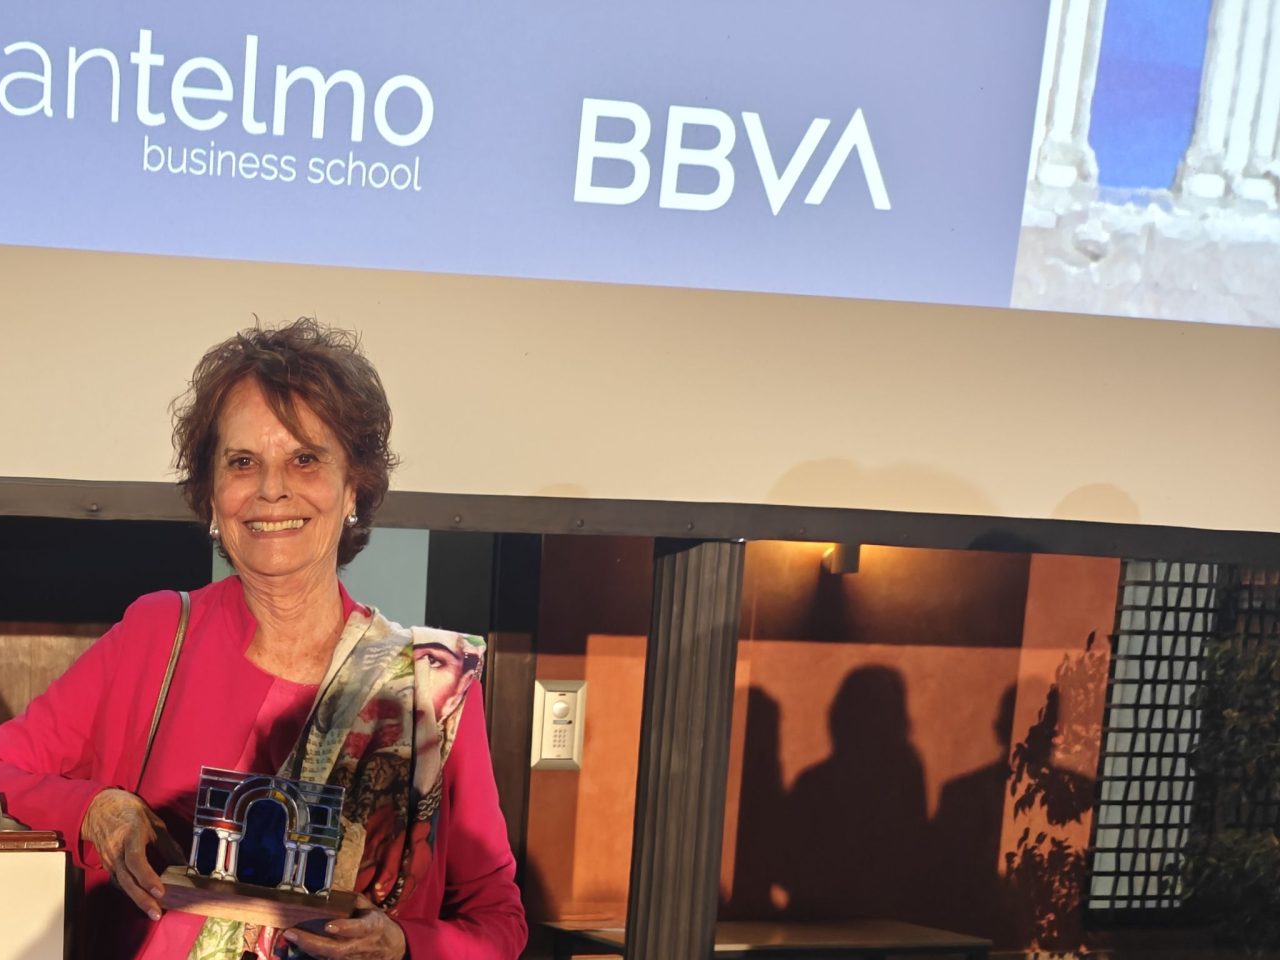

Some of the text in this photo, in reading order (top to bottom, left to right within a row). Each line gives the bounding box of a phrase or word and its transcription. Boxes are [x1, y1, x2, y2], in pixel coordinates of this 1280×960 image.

[142, 134, 422, 192] business school
[573, 97, 892, 217] BBVA
